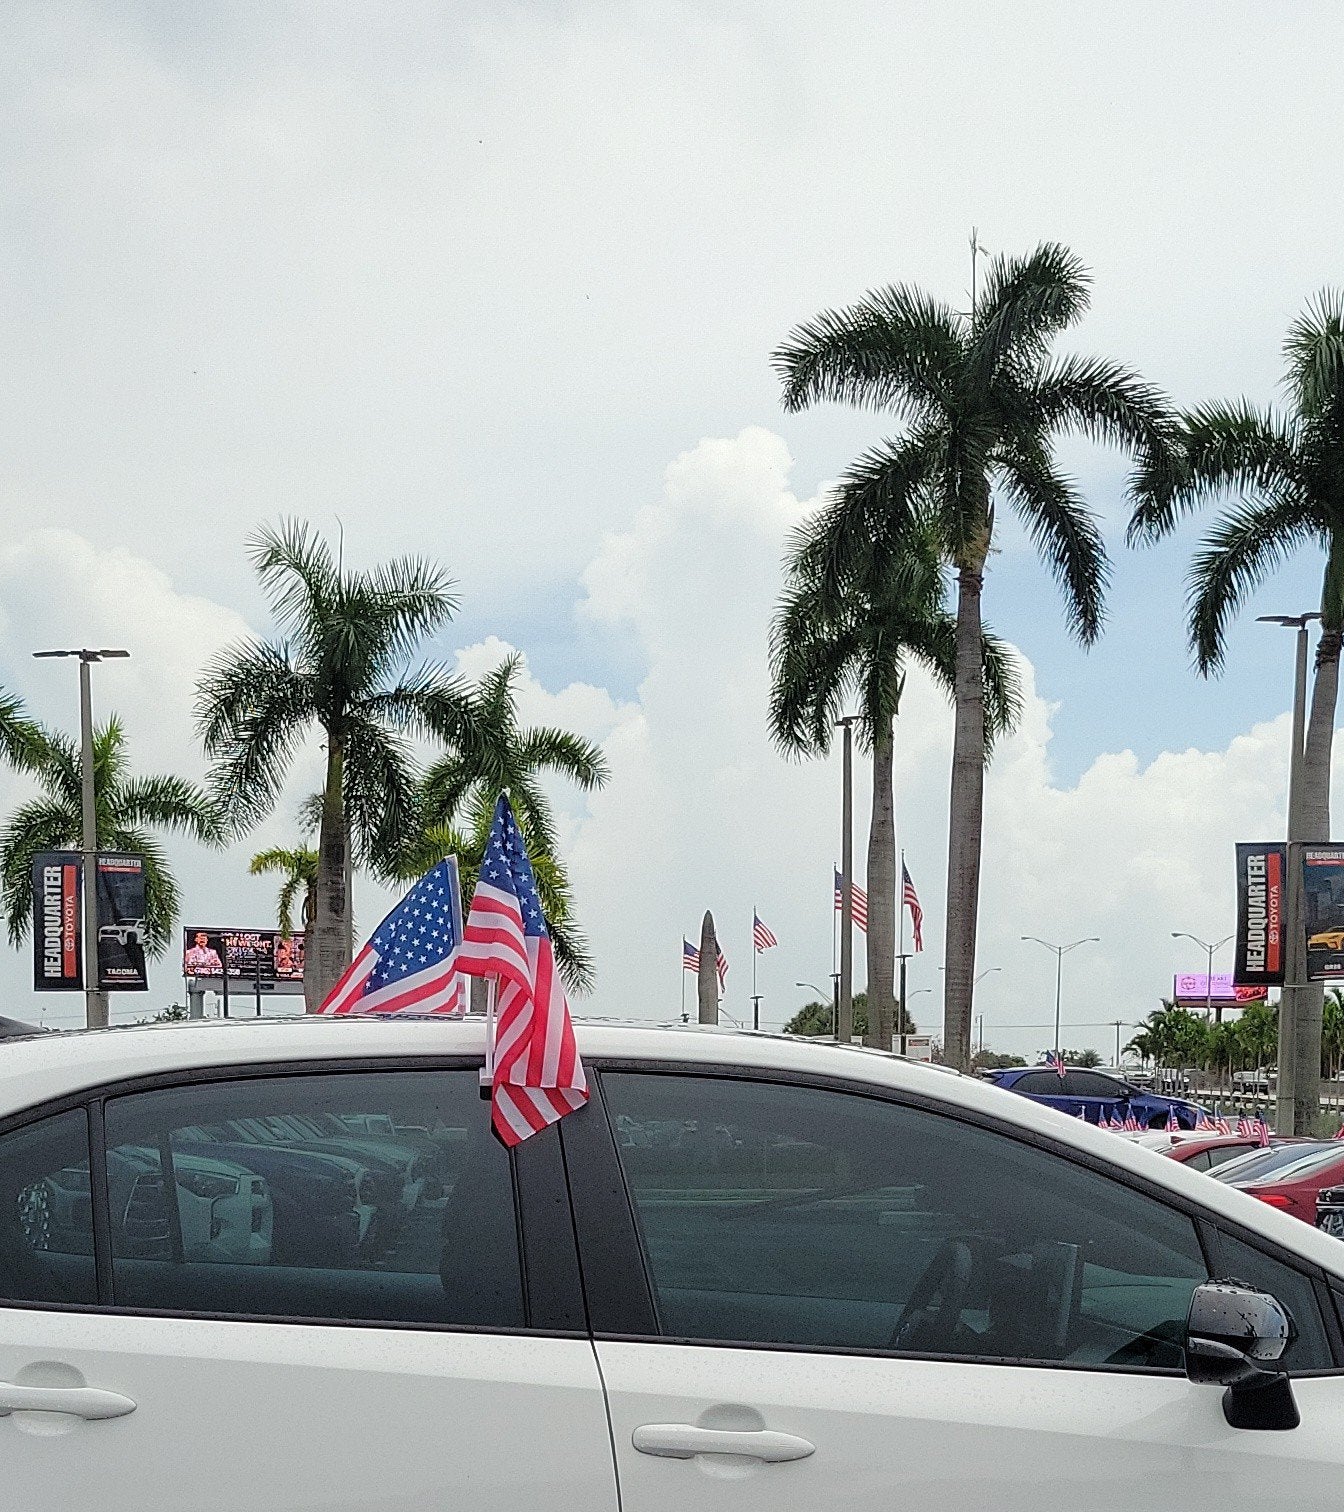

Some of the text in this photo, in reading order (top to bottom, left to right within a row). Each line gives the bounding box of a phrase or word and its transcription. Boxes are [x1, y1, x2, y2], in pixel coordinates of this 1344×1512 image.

[44, 866, 63, 977] HEADQUARTER
[65, 896, 74, 937] TOYOTA
[1246, 854, 1267, 972] HEADQUARTER
[1269, 885, 1280, 932] TOYOTA
